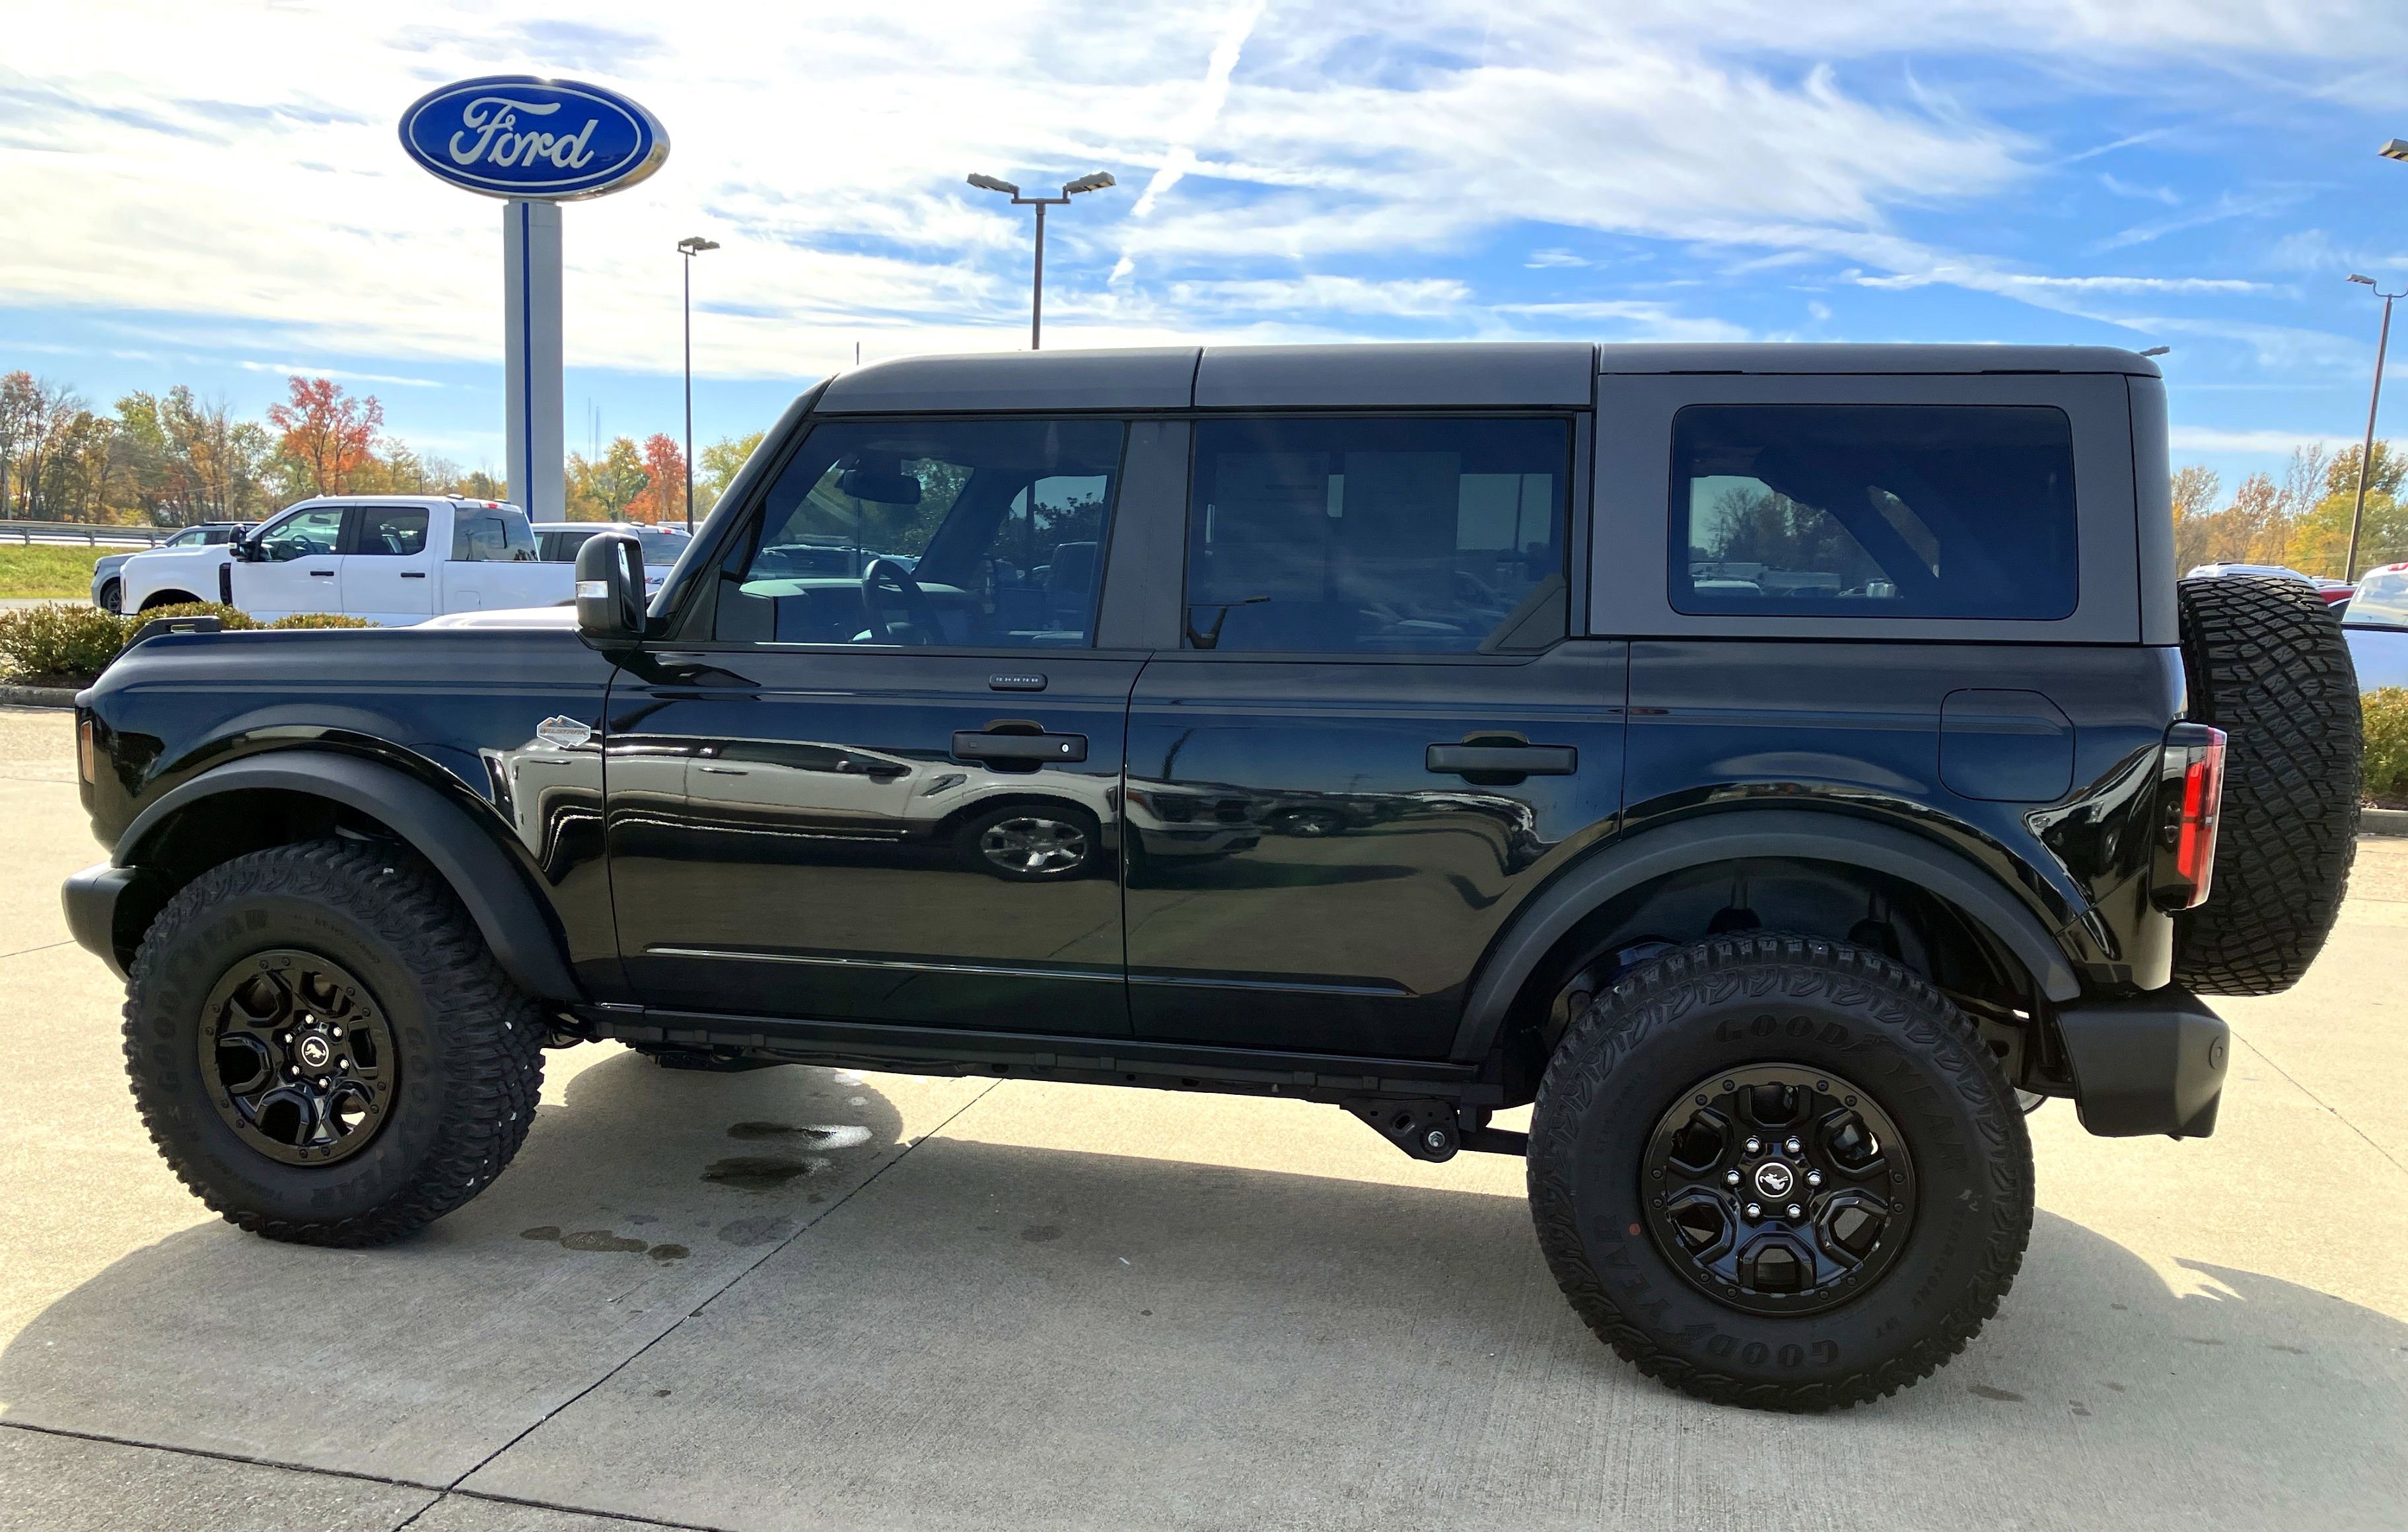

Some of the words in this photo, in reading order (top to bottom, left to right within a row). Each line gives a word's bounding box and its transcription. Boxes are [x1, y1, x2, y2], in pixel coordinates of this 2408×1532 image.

[449, 96, 599, 168] Ford
[1715, 1014, 1969, 1173] GOODYEAR
[1593, 1213, 1840, 1371] GOODYEAR
